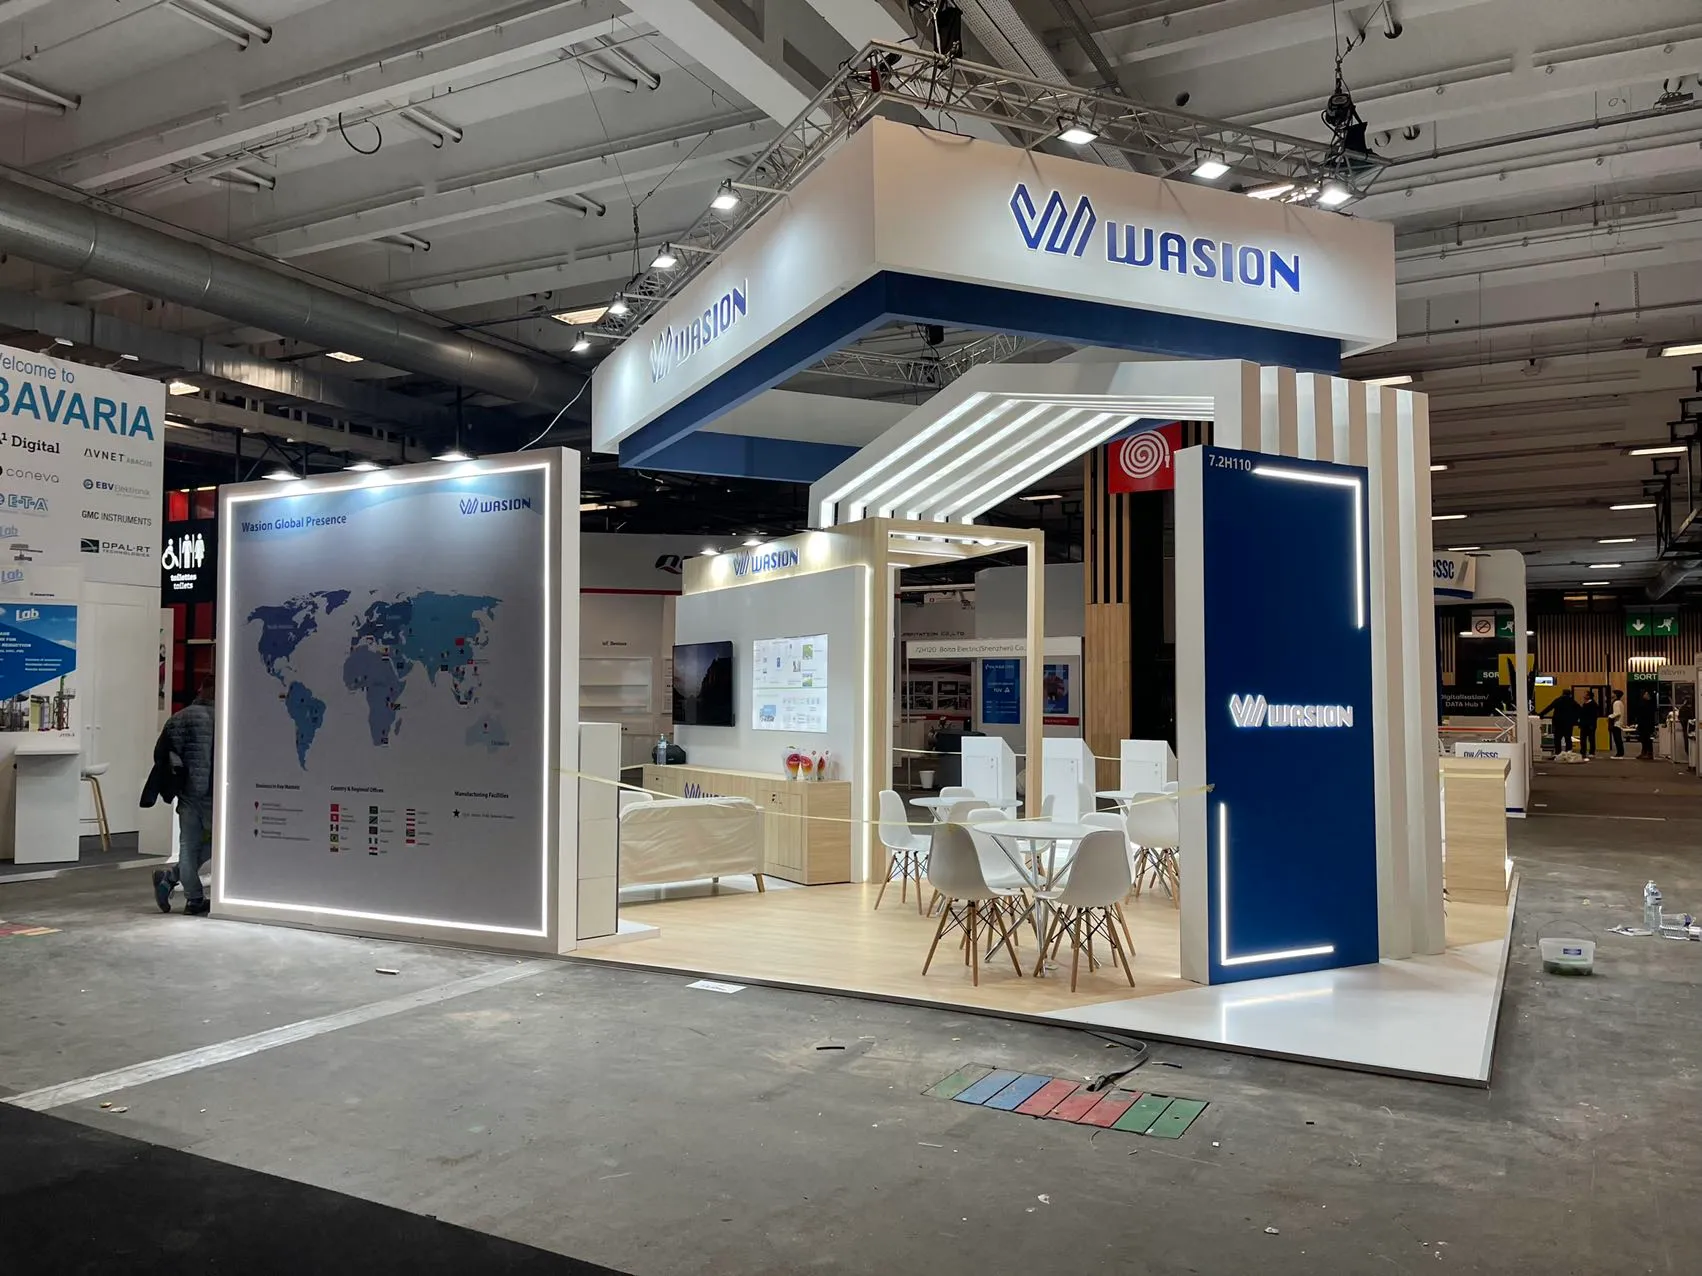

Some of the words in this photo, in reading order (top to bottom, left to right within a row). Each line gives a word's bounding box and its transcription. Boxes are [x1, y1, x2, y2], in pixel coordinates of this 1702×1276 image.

[1105, 221, 1300, 293] WASION
[675, 278, 748, 368] WASION
[0, 353, 57, 380] elcome
[61, 367, 75, 384] to
[11, 435, 60, 454] Digital
[1209, 454, 1252, 471] 7.2H110
[6, 468, 60, 484] coneva
[96, 481, 114, 491] EBV
[480, 497, 531, 513] WASION
[82, 510, 100, 520] GMC
[101, 513, 152, 526] INSTRUMENTS
[242, 522, 273, 533] Wasion
[275, 517, 304, 530] Global
[306, 515, 347, 528] Presence
[751, 548, 800, 573] WASION
[15, 608, 40, 622] Lab
[1268, 704, 1354, 728] WASION
